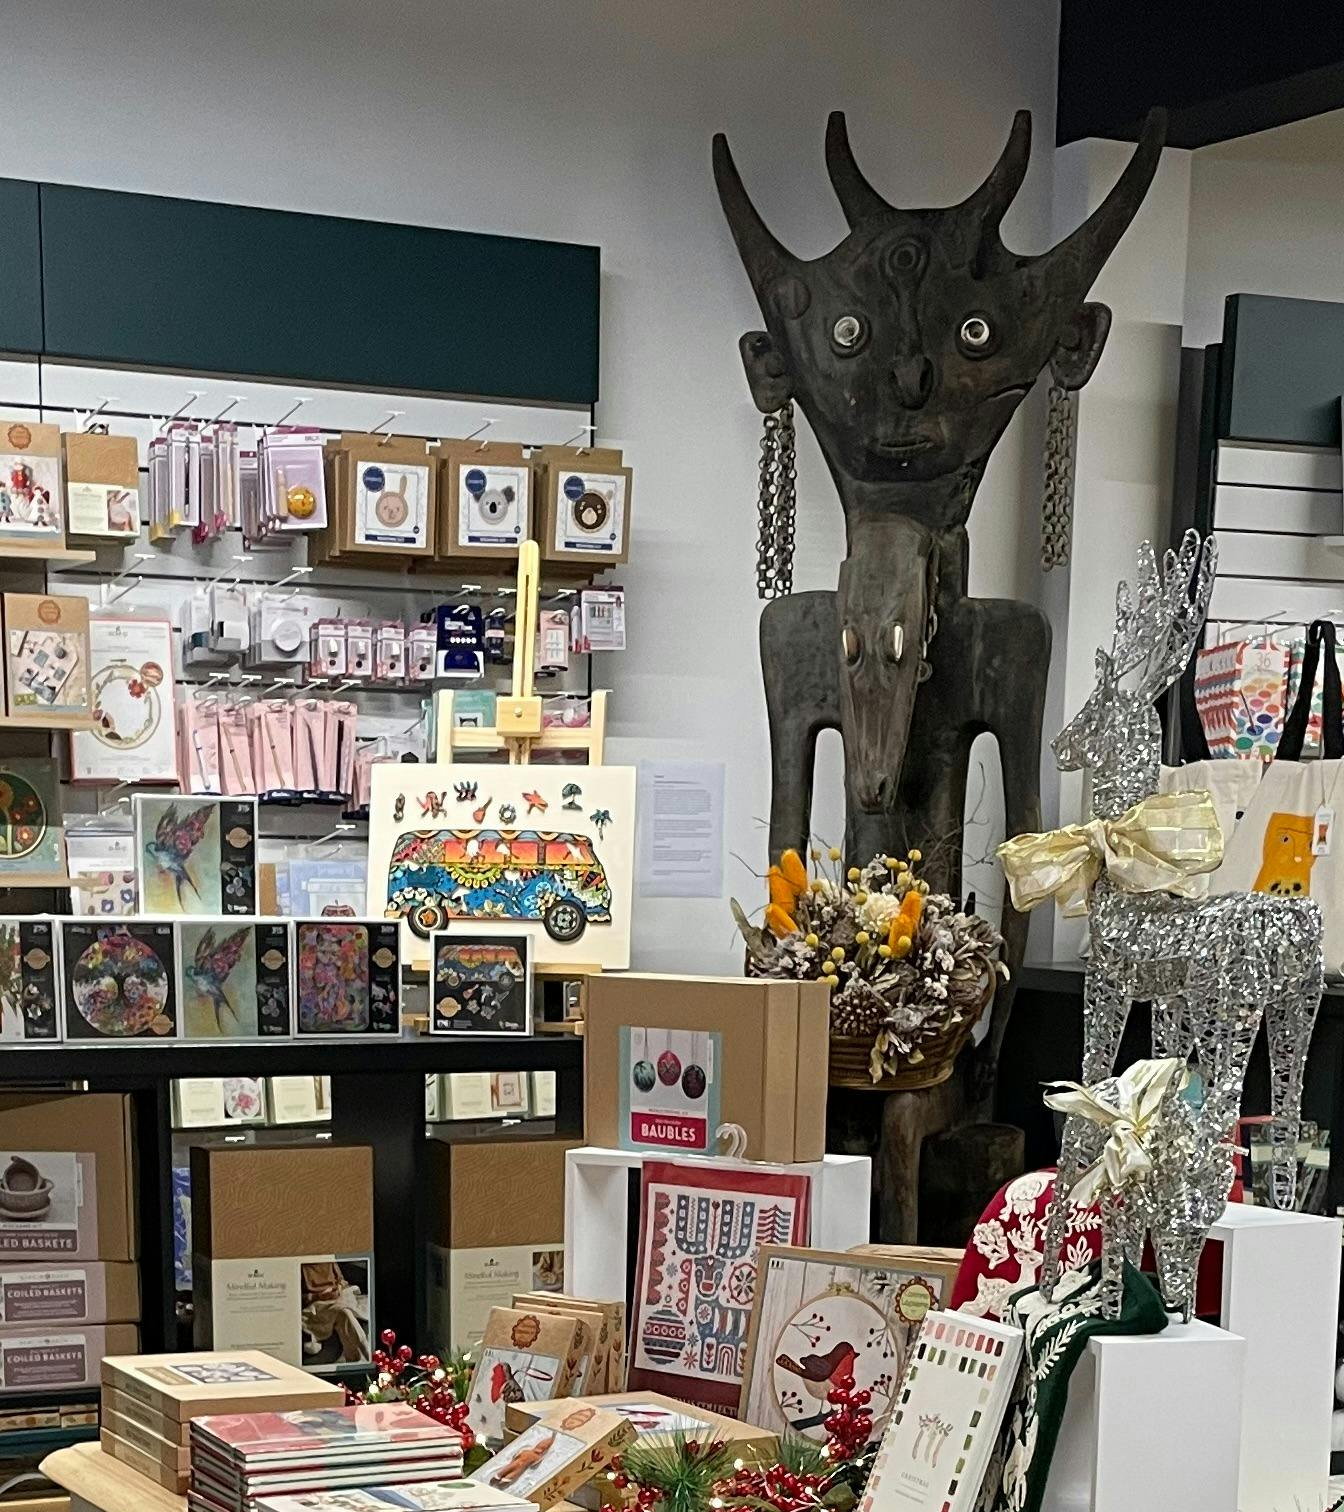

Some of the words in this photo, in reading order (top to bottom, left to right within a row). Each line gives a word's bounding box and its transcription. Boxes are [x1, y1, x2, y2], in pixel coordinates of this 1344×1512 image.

[641, 1123, 696, 1142] BAUBLES
[22, 1237, 74, 1249] BASKETS
[7, 1287, 41, 1299] COILED
[43, 1286, 83, 1297] BASKETS
